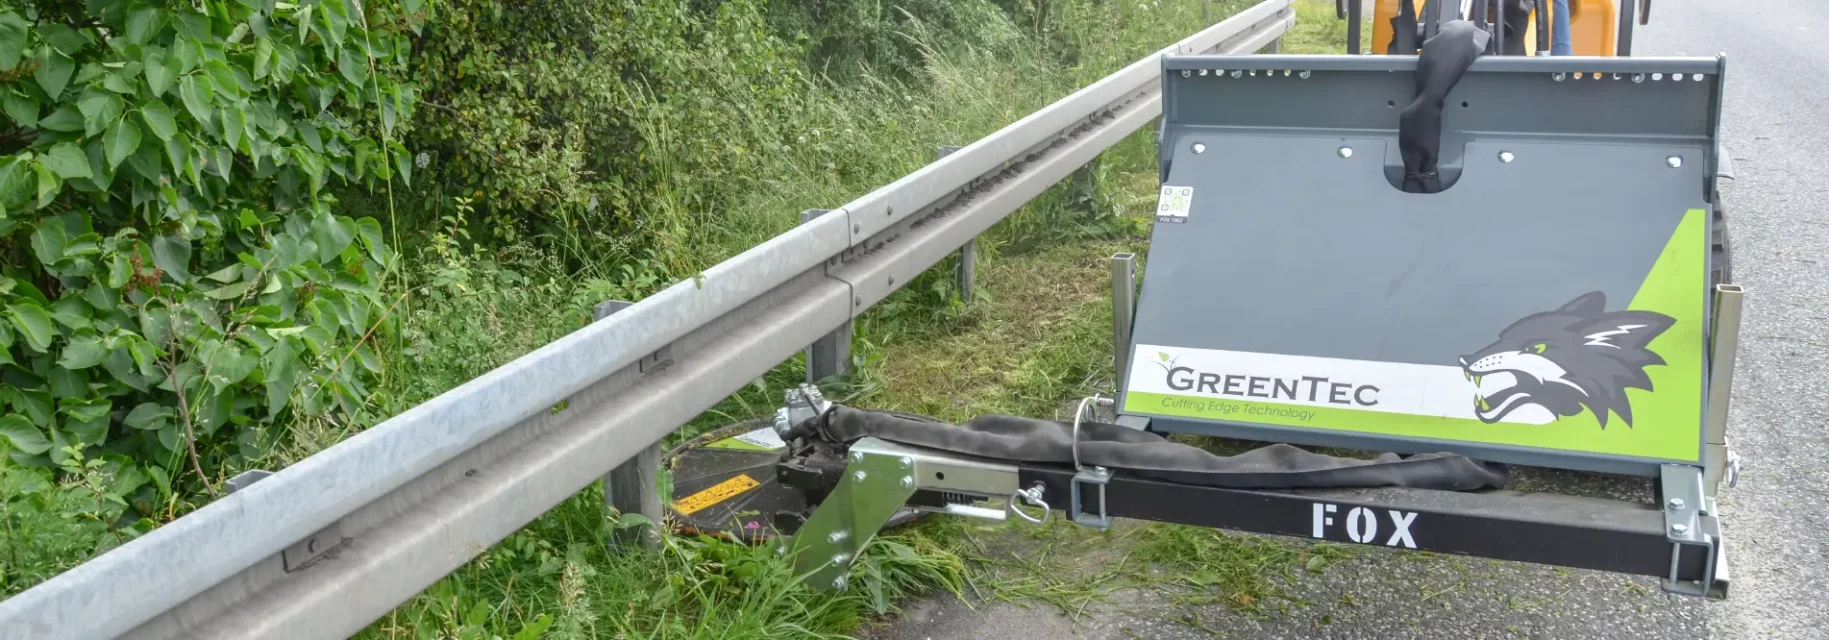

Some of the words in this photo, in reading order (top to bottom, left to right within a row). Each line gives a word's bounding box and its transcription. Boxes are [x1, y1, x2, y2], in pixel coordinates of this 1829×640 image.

[1161, 397, 1205, 413] Cutting
[1207, 402, 1240, 415] Edge
[1243, 404, 1316, 421] Technology
[1313, 503, 1418, 549] FOX
